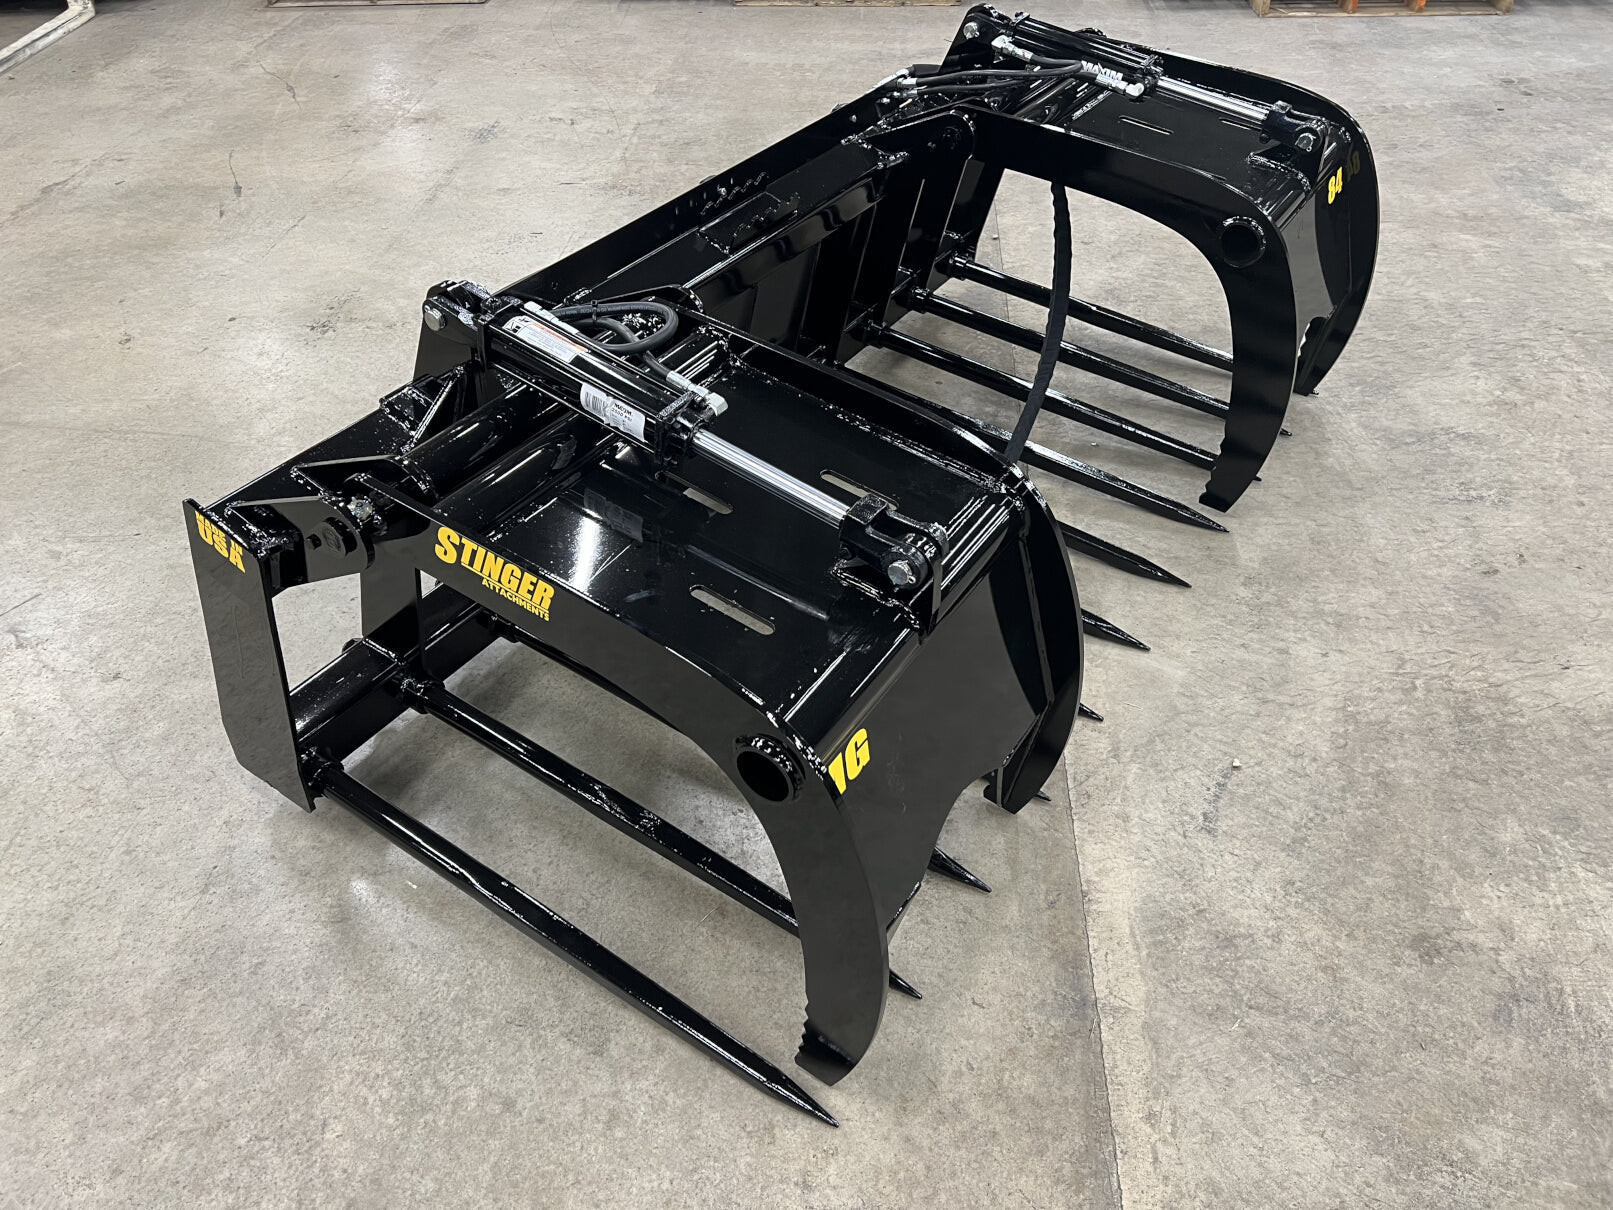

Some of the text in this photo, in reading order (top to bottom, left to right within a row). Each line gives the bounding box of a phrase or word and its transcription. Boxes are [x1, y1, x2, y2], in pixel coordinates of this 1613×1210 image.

[1080, 59, 1124, 81] MAXIM
[1327, 166, 1343, 205] 84
[197, 518, 246, 574] USA
[434, 526, 555, 611] STINGER
[481, 578, 550, 622] ATTACHMENTS
